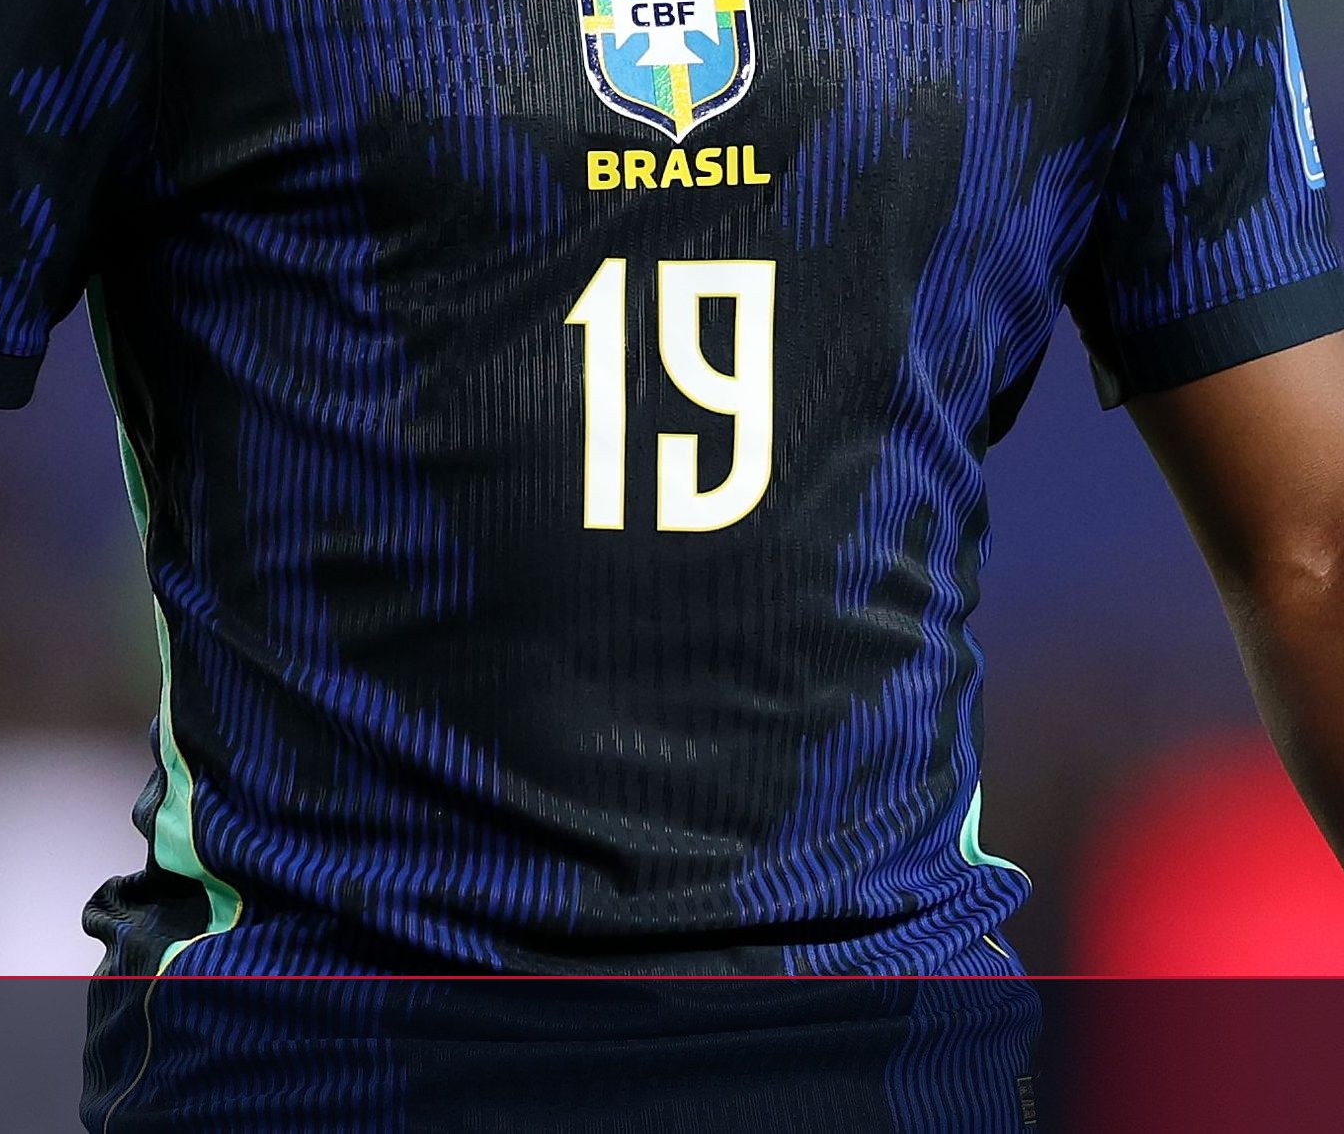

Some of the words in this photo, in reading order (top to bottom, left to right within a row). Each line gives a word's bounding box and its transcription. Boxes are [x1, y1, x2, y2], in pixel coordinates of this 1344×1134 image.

[631, 1, 696, 27] CBF
[587, 145, 771, 190] BRASIL
[564, 257, 777, 532] 19
